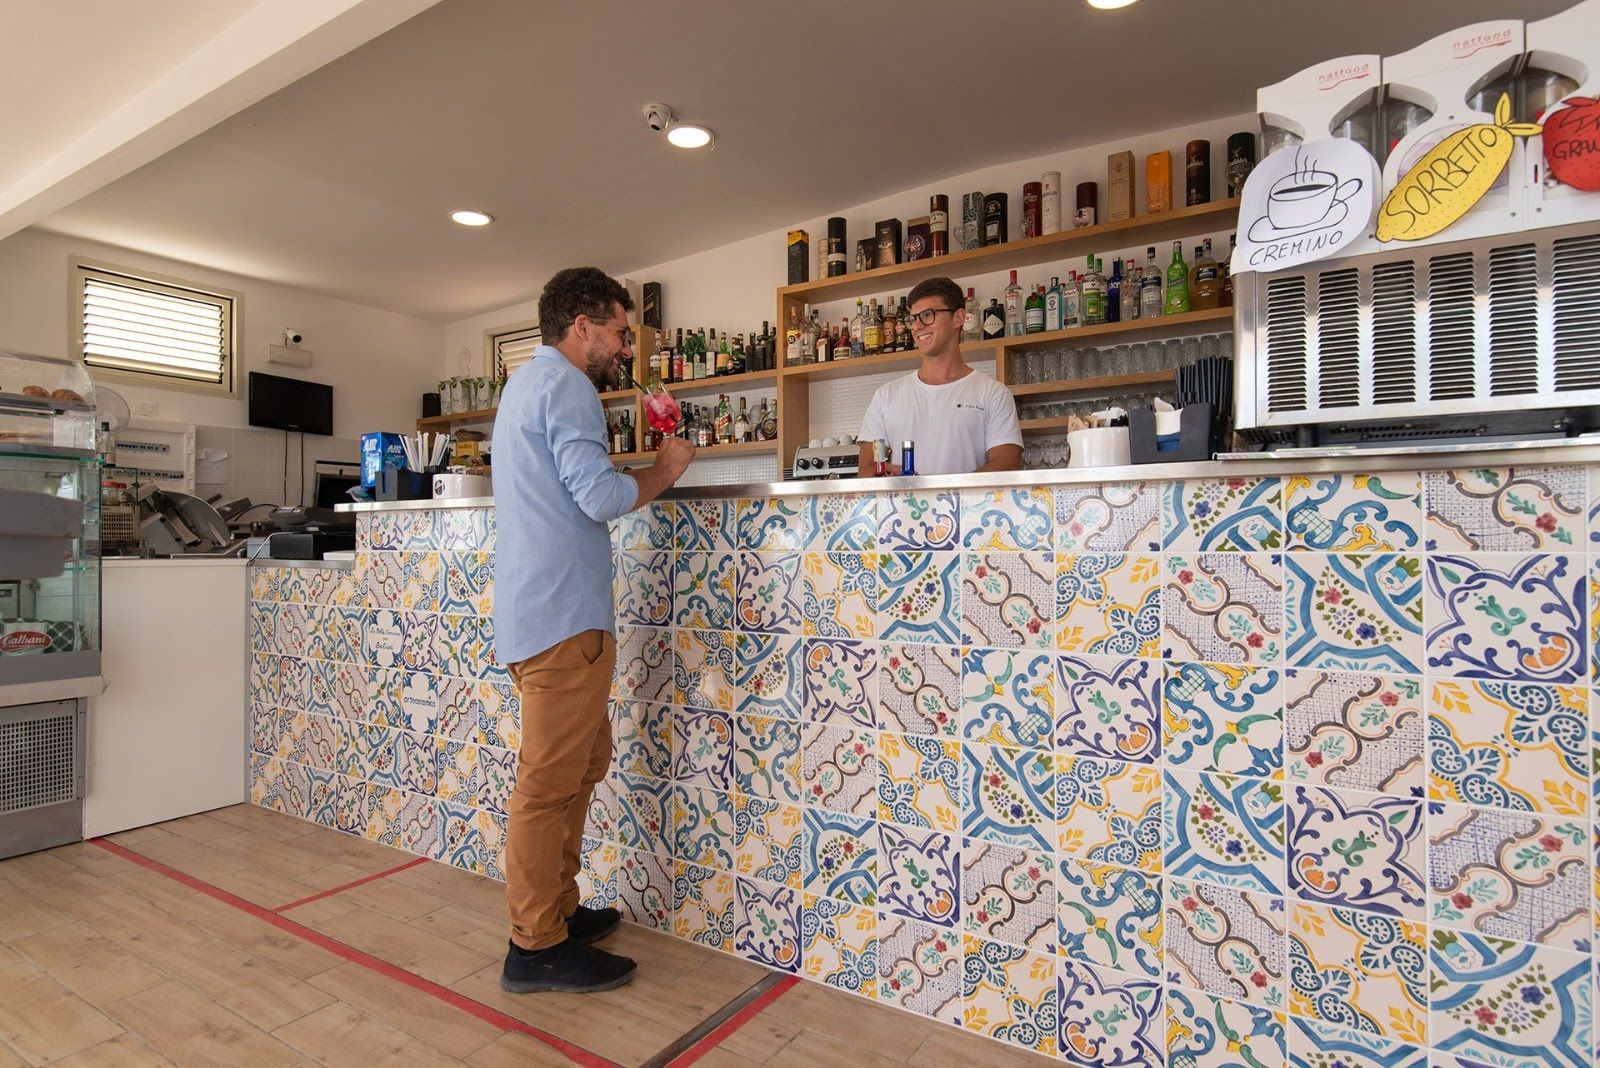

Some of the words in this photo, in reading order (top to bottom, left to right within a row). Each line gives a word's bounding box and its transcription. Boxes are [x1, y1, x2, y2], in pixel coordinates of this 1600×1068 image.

[1453, 29, 1512, 48] natfood
[1317, 63, 1370, 81] natfood
[1385, 127, 1498, 235] SORBETTO
[1249, 230, 1344, 267] CREMINO
